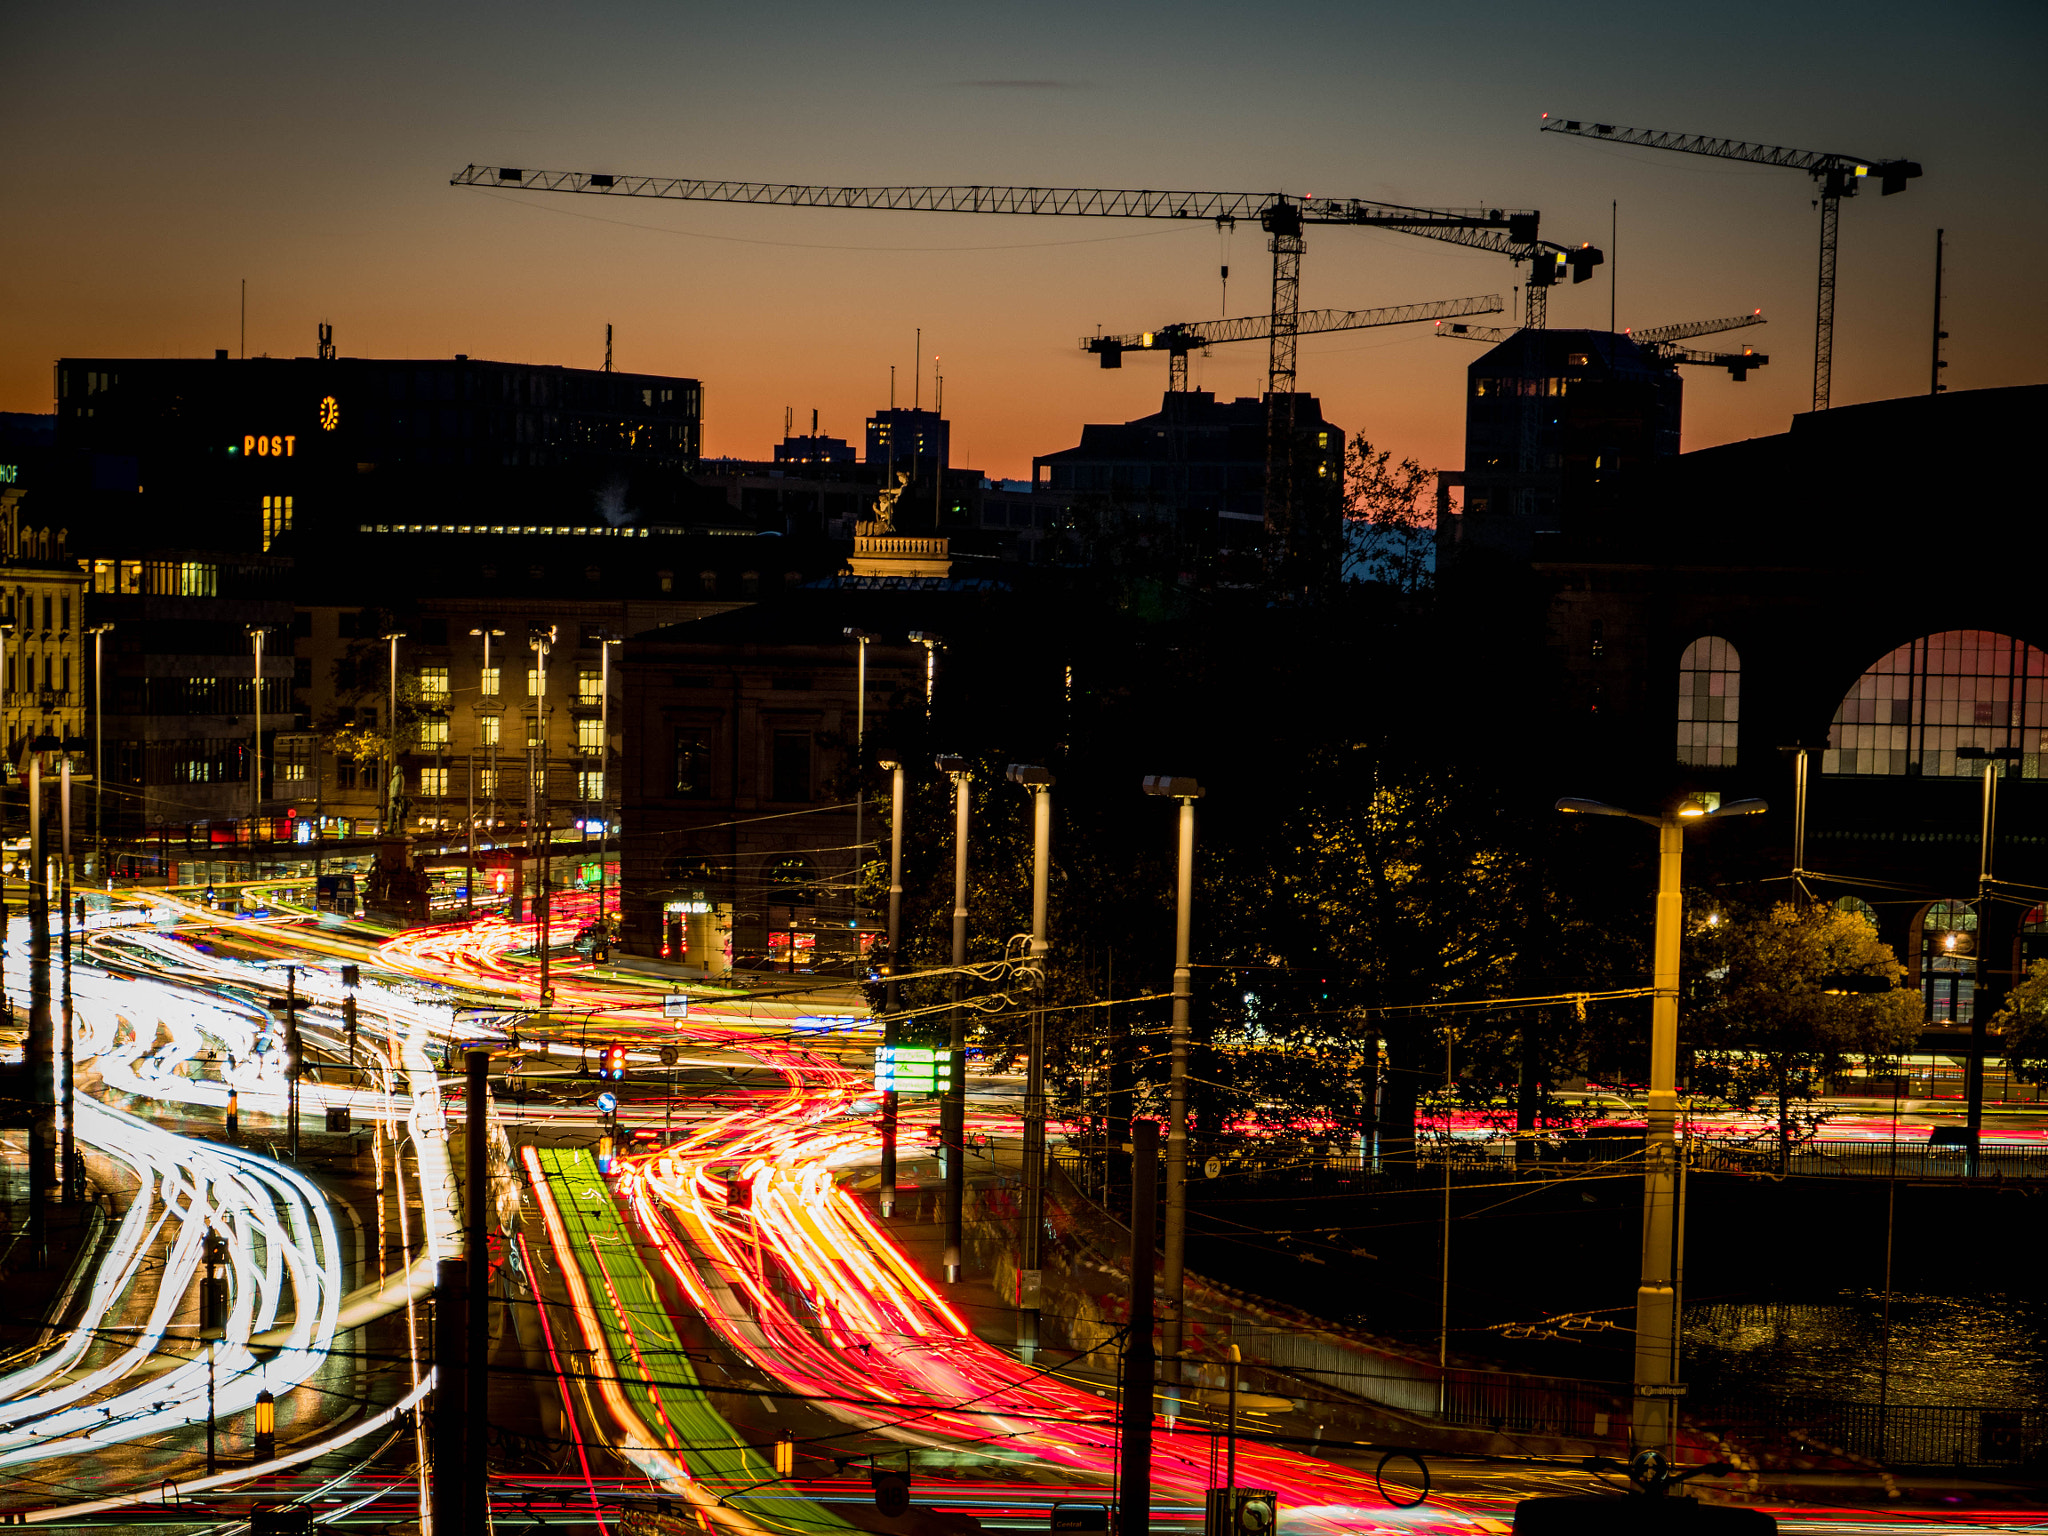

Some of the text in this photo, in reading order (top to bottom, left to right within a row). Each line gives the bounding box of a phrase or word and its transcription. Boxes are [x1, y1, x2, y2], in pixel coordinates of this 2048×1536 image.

[244, 435, 296, 456] POST
[692, 891, 705, 901] 36
[692, 902, 714, 913] DEA
[1209, 1162, 1218, 1172] 12
[1056, 1520, 1082, 1528] Central
